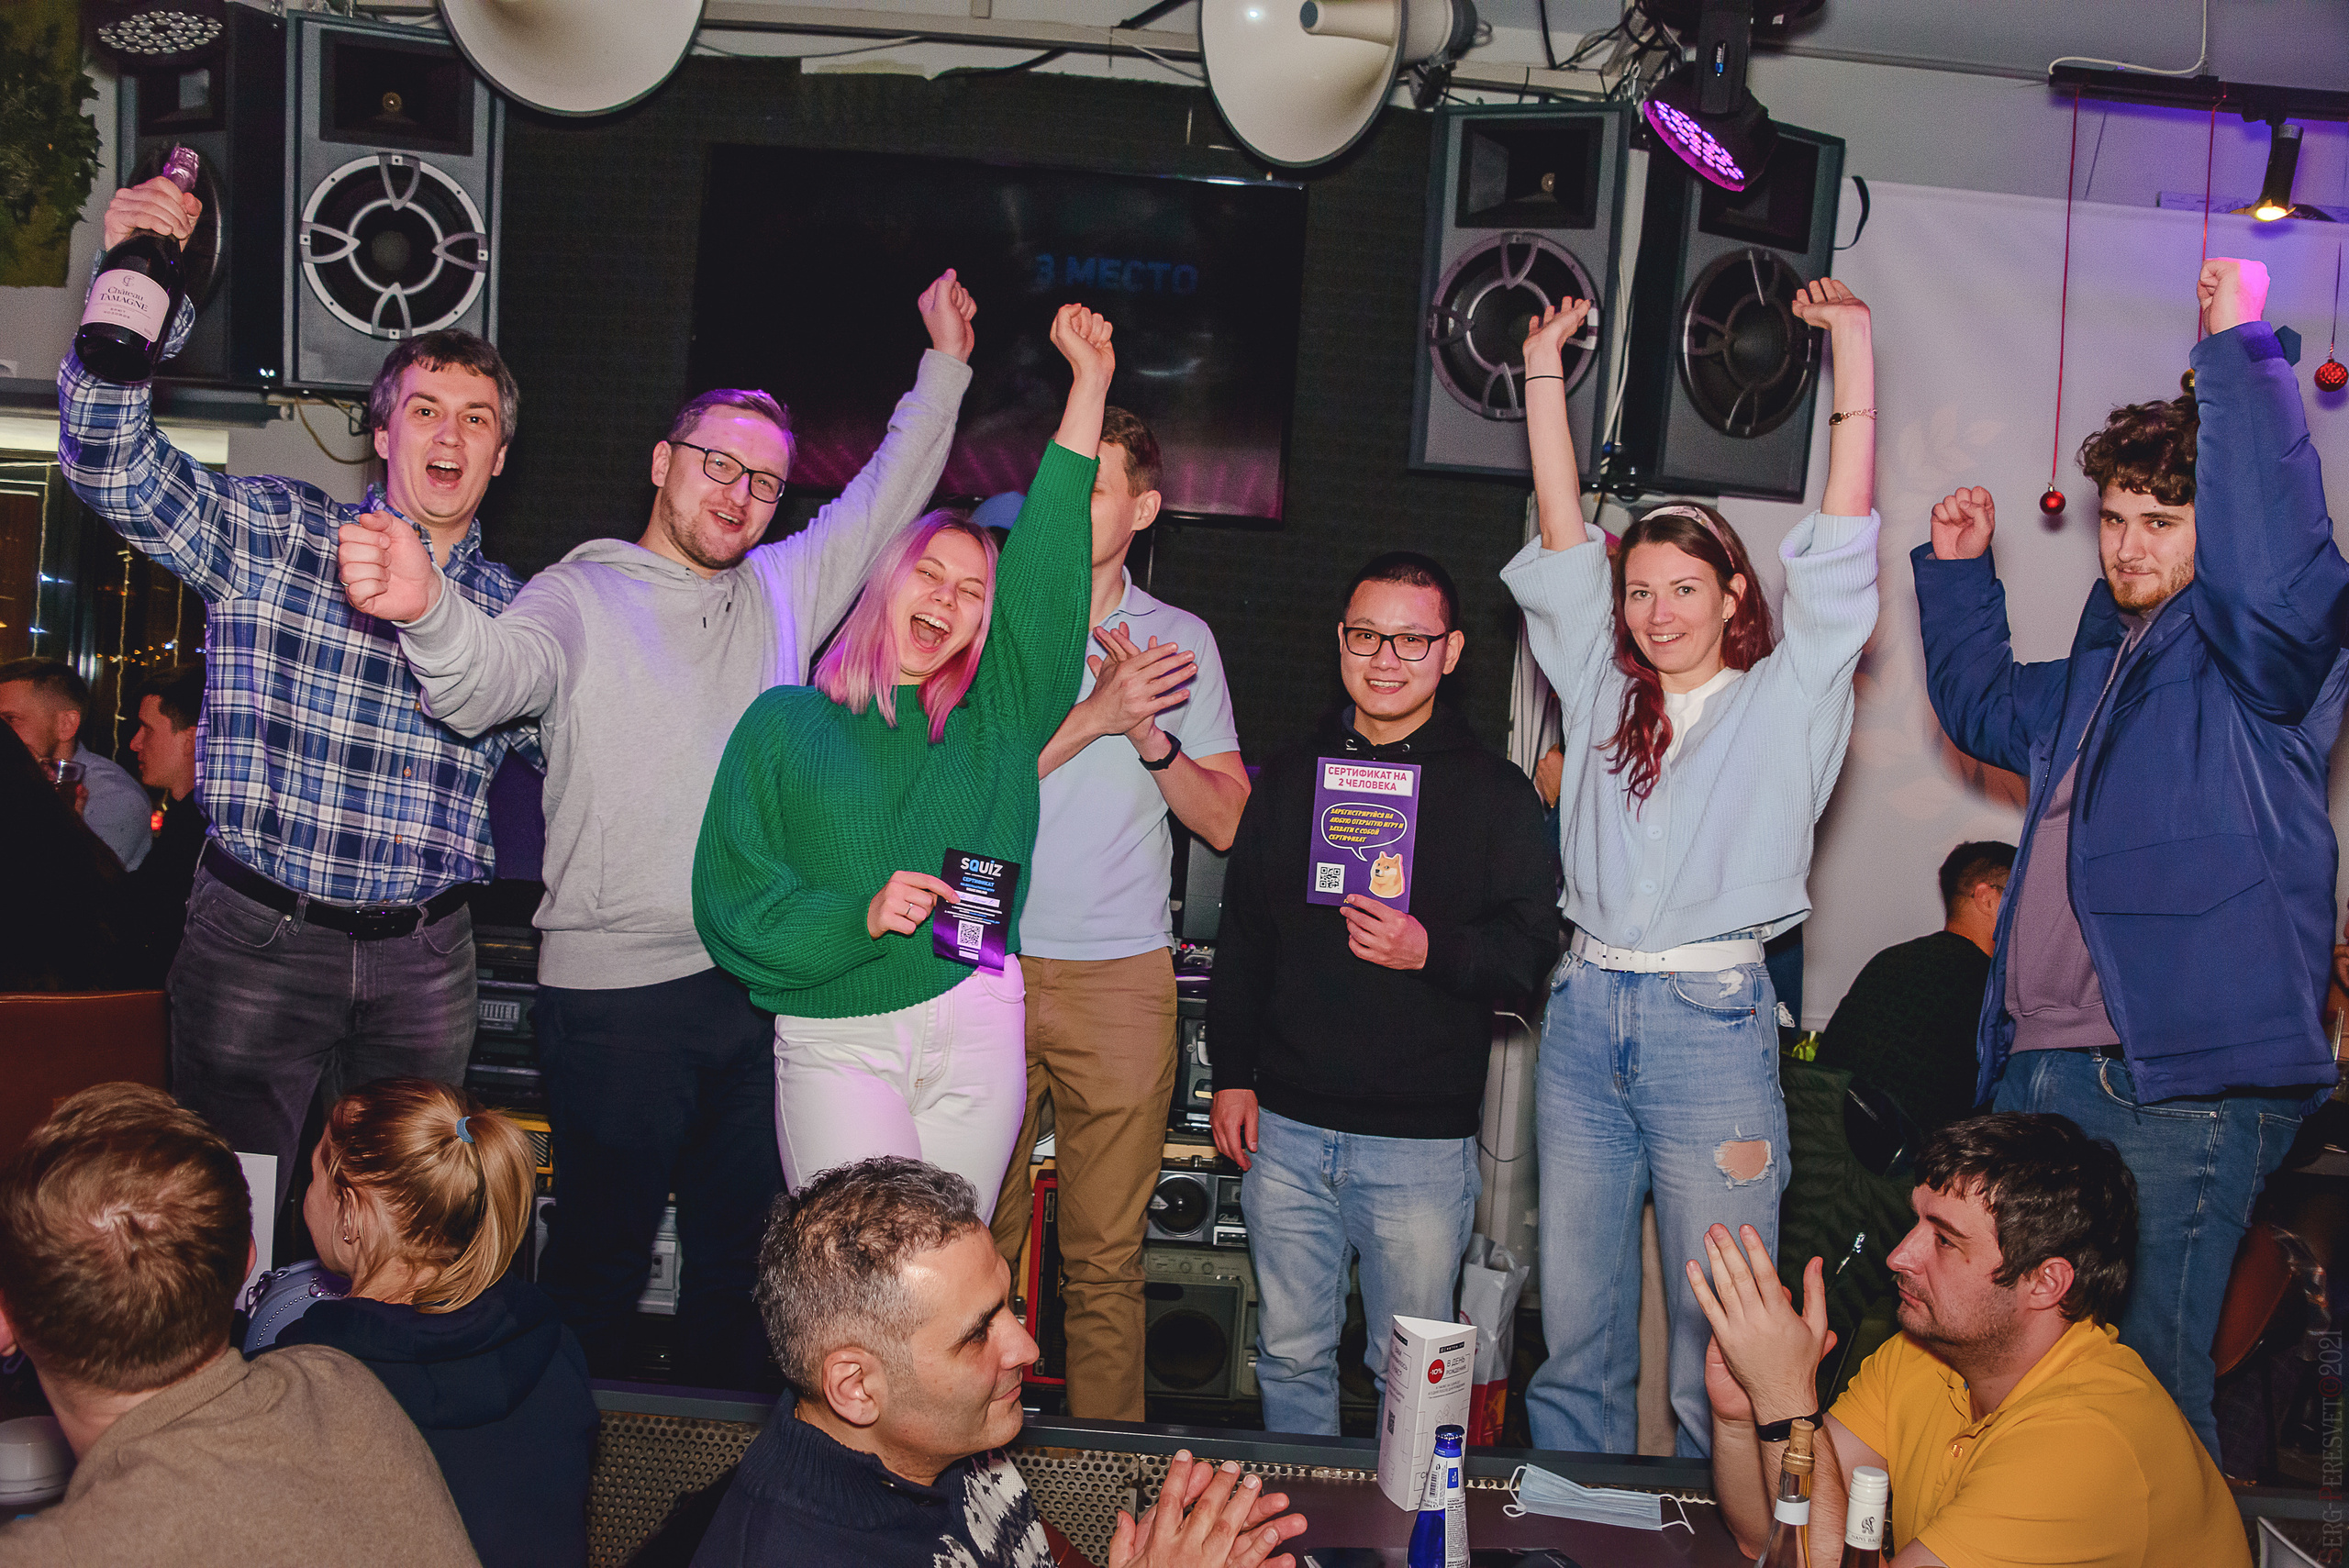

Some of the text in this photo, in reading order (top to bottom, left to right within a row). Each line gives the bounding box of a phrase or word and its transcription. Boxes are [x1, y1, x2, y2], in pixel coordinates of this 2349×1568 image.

[1065, 255, 1198, 295] МЕСТО
[100, 293, 149, 313] TAMAGNE
[1328, 766, 1407, 781] СЕРТИФИКАТ НА
[1338, 778, 1397, 791] 2 ЧЕЛОВЕКА
[1329, 834, 1367, 842] СЕРТИФИКАТ
[1447, 1356, 1465, 1367] В ДЕНЬ
